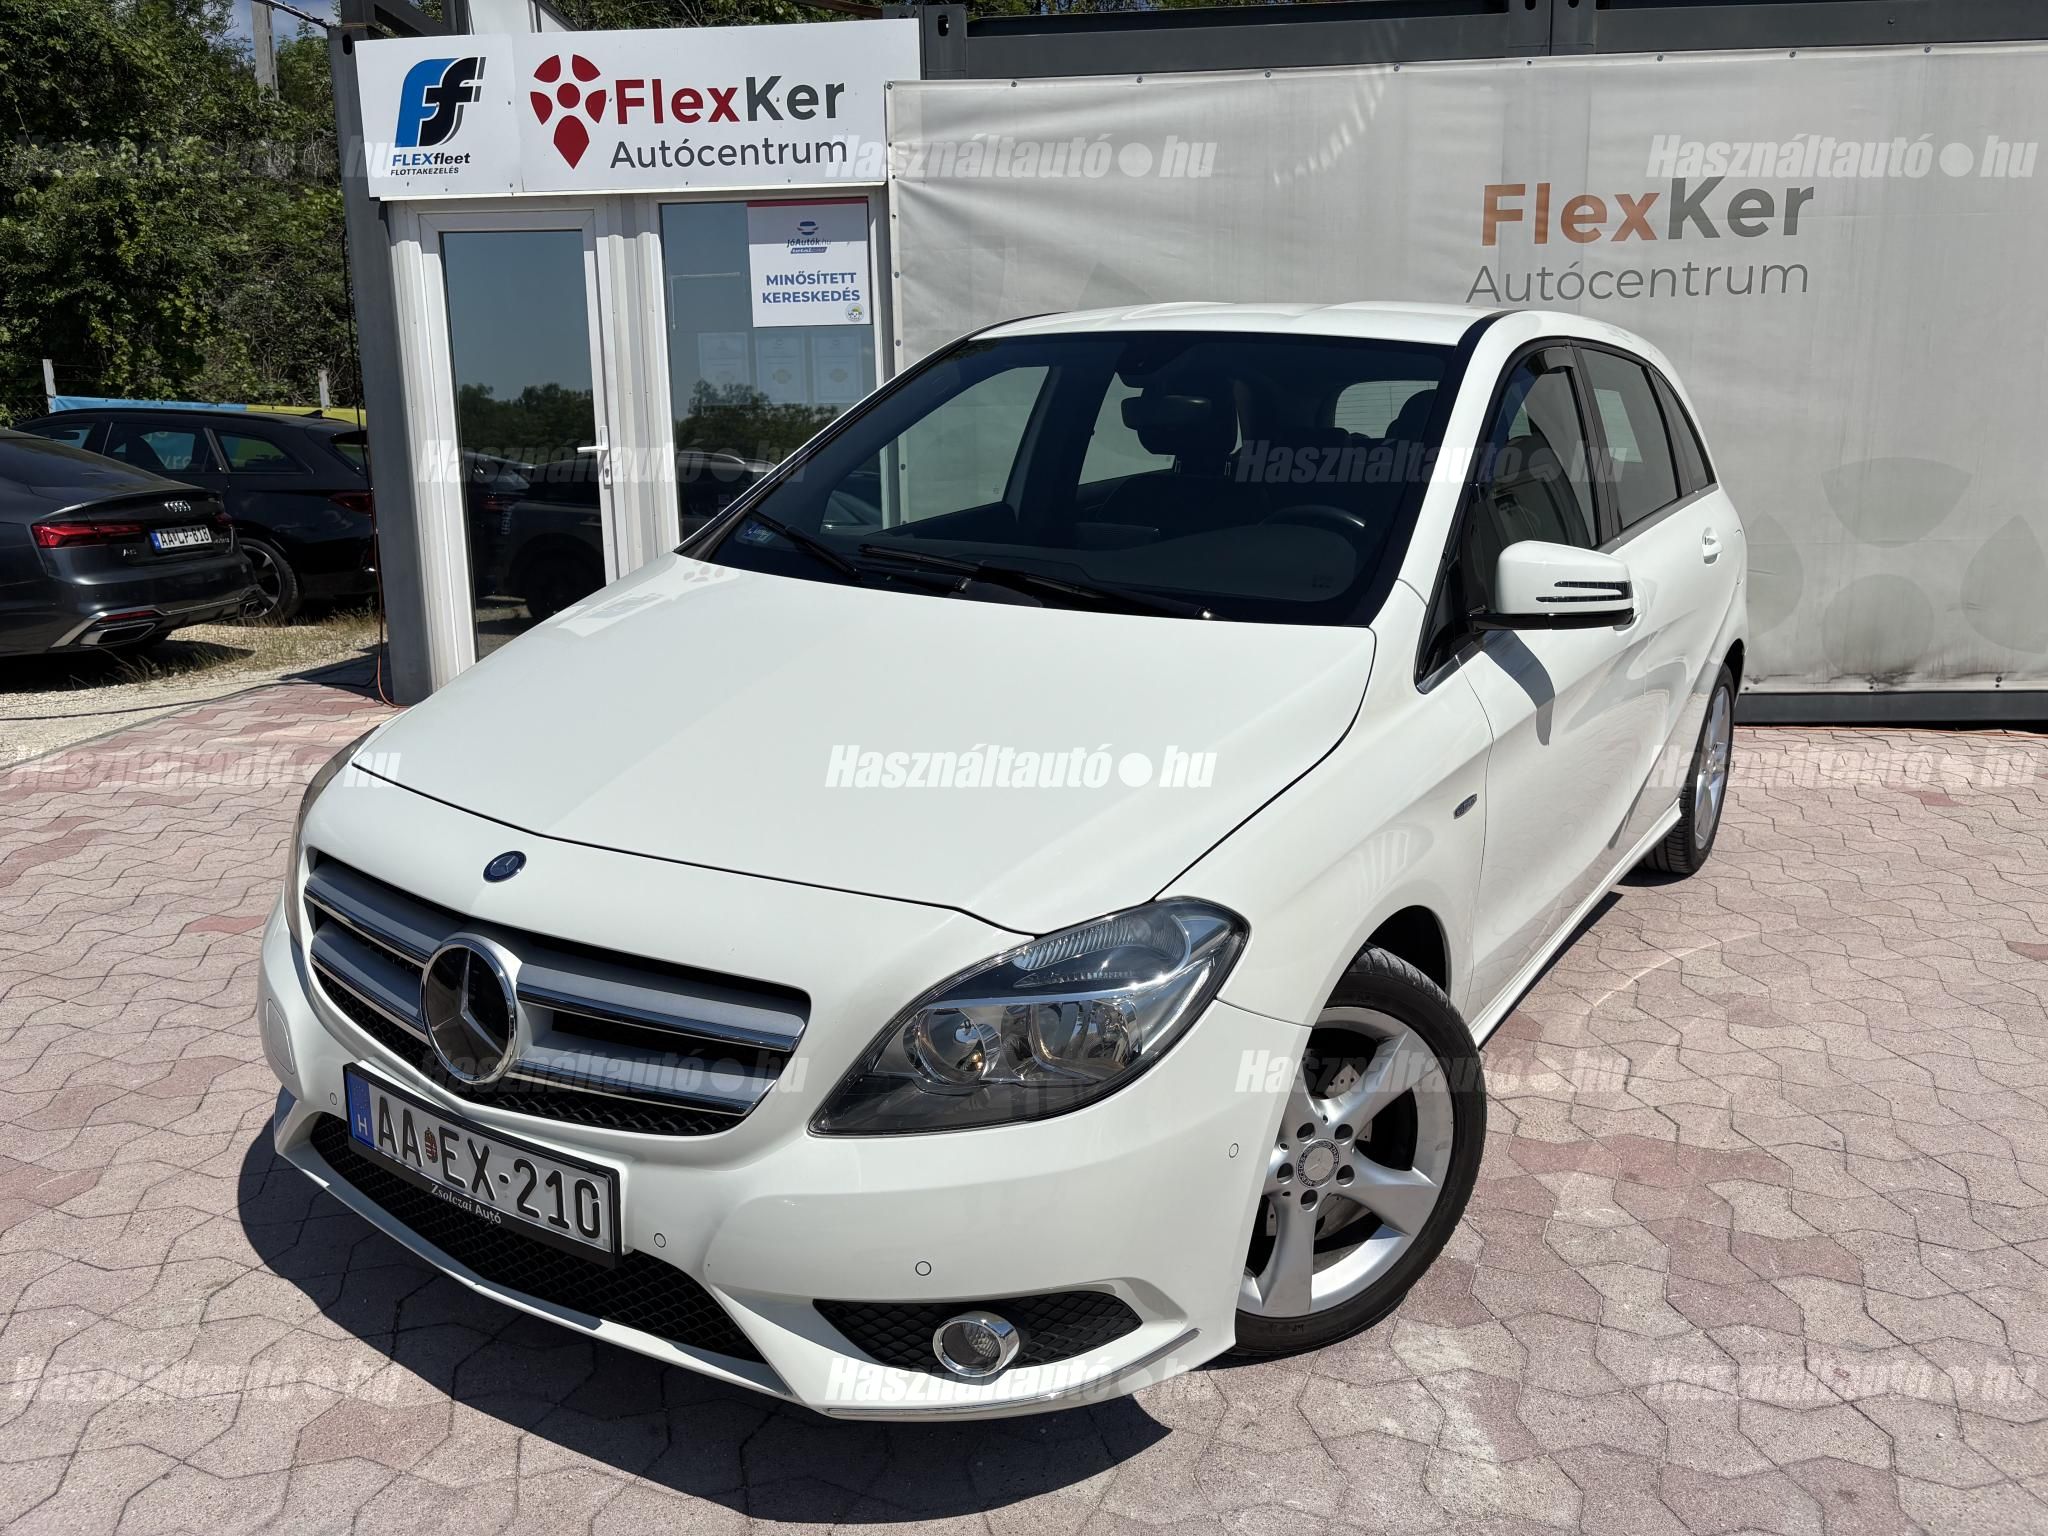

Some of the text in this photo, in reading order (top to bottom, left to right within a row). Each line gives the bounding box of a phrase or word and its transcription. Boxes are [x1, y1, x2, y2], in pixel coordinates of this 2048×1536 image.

[615, 75, 845, 125] FlexKer
[392, 153, 471, 166] FLEXfleet
[610, 137, 848, 169] Autócentrum
[390, 166, 459, 176] FLOTTAKEZELÉS
[1482, 175, 1814, 246] FlexKer
[766, 270, 857, 286] MINŐSÍTETT
[1466, 260, 1808, 304] Autócentrum
[762, 287, 861, 304] KERESKEDÉS
[431, 1183, 502, 1225] Zsolczai Autó
